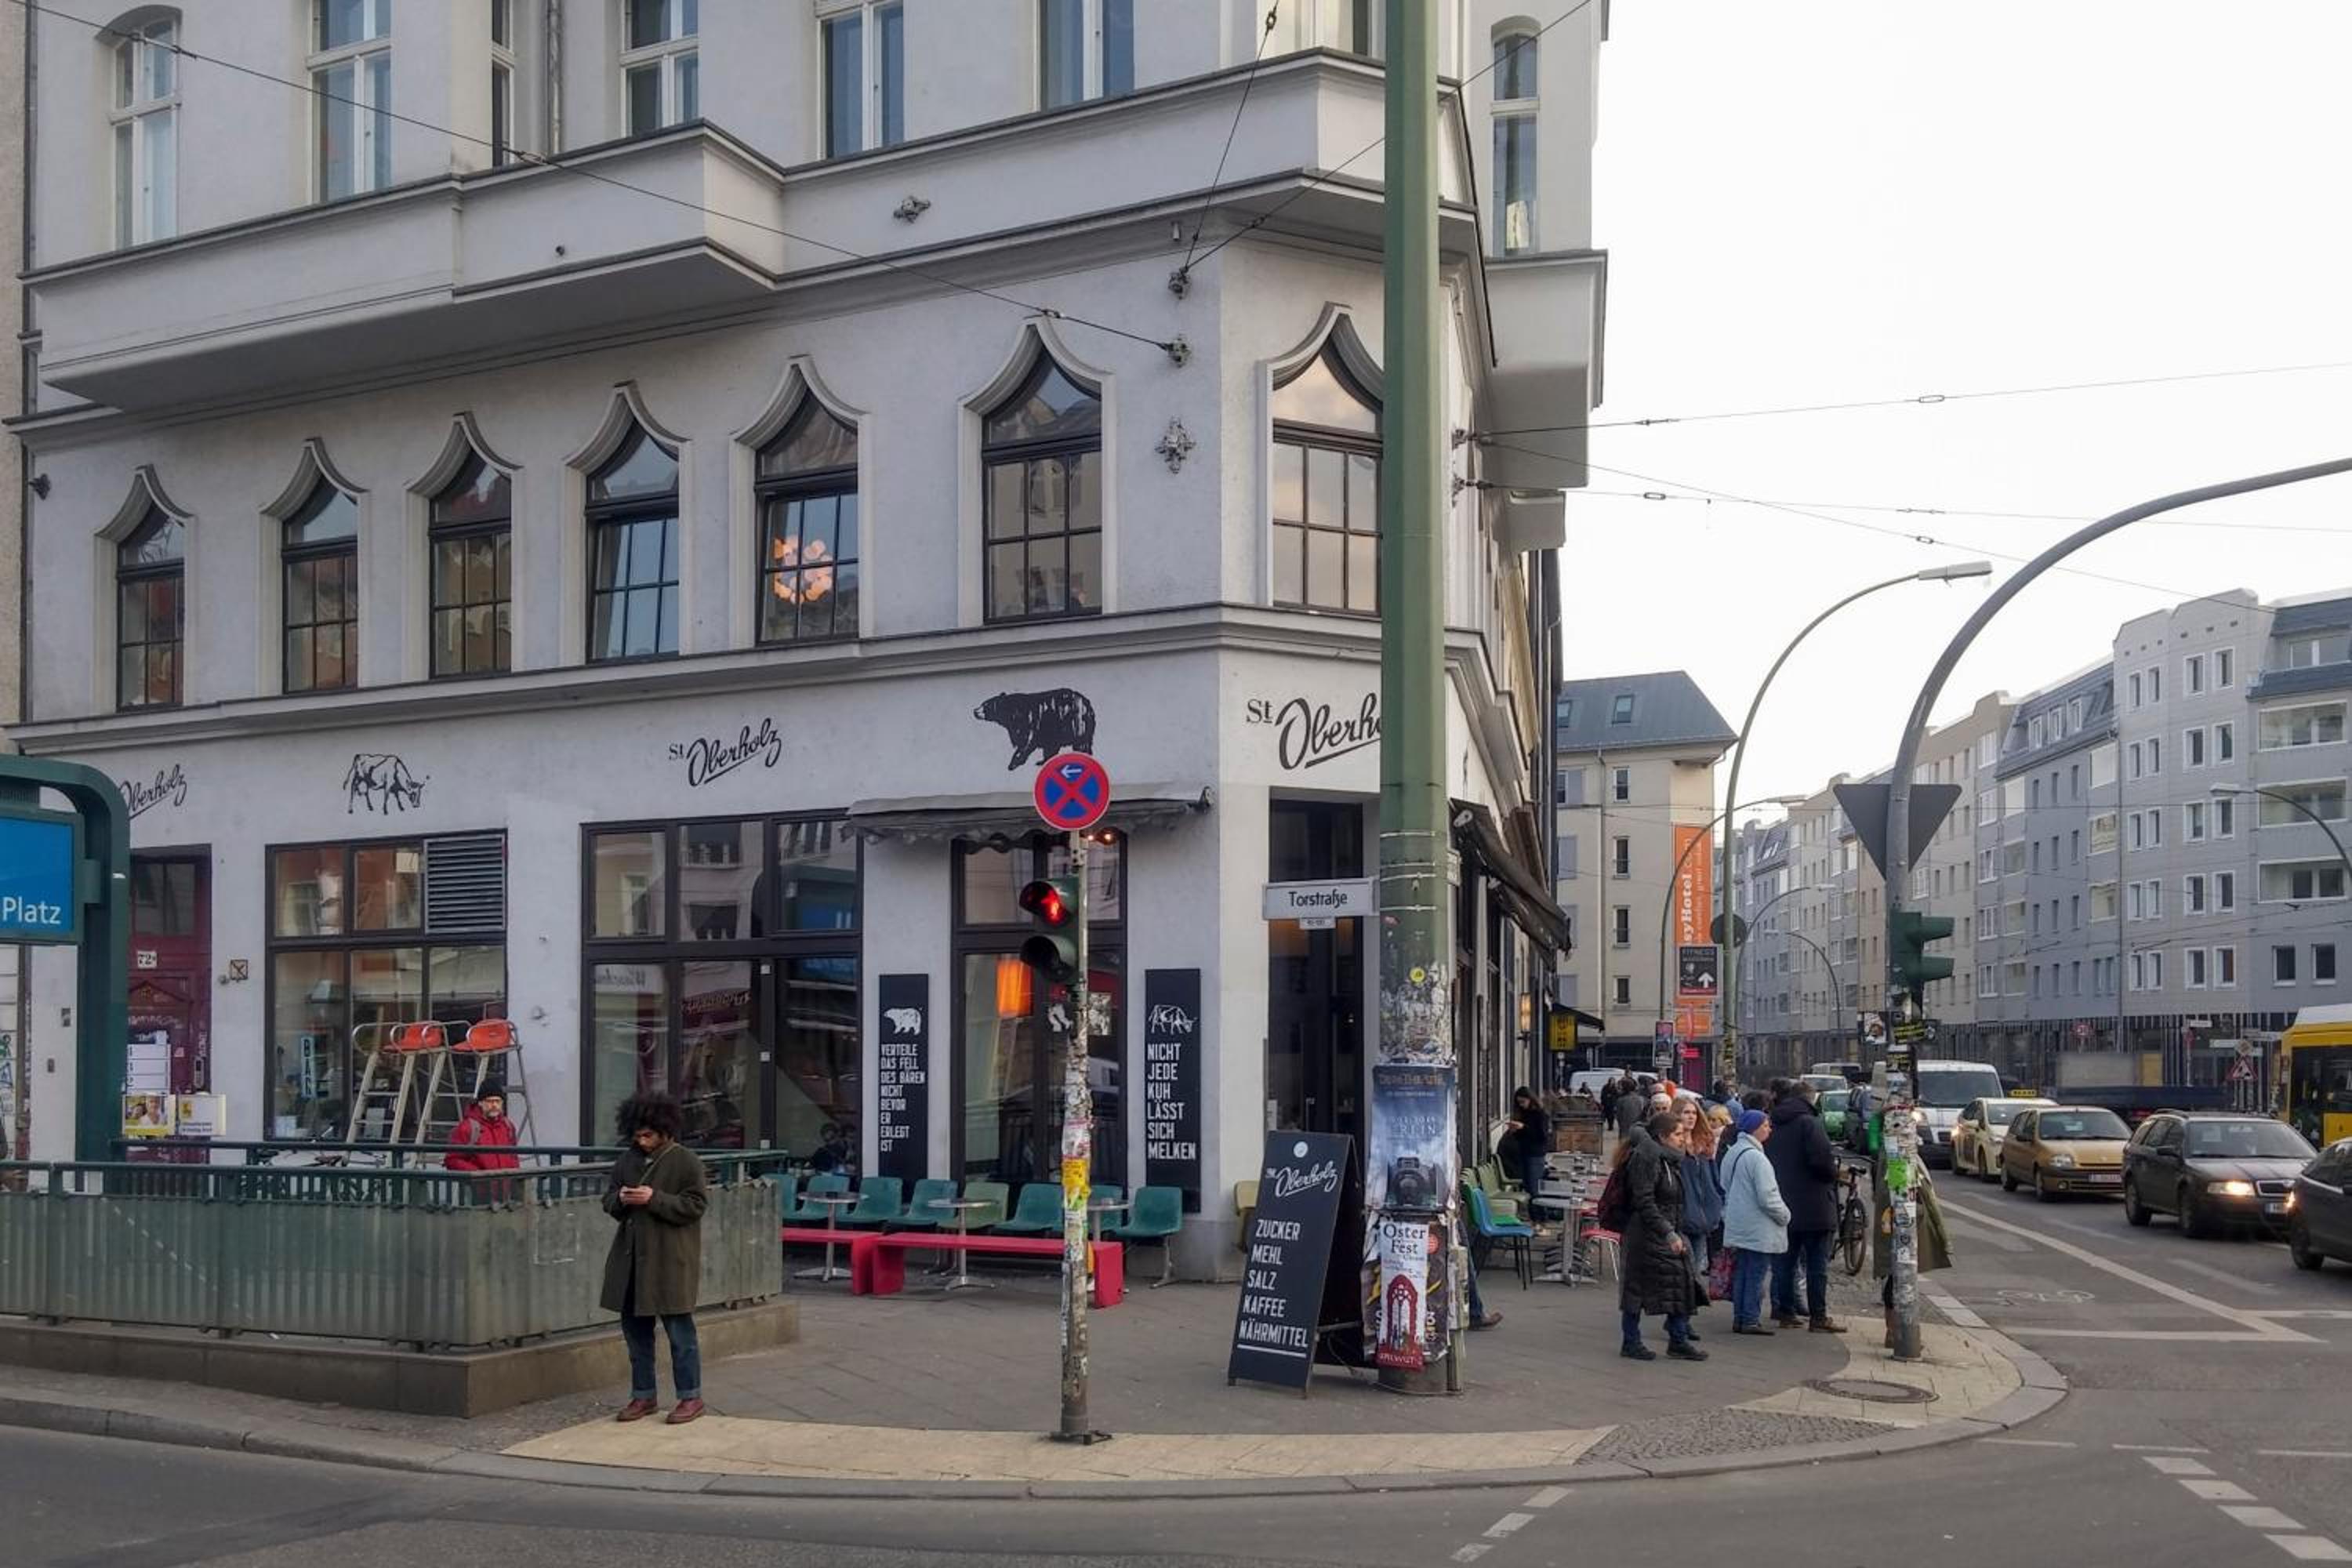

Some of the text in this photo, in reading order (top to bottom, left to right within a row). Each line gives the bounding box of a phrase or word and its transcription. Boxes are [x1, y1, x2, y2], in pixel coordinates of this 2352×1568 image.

[1247, 692, 1381, 769] St Oberh
[669, 717, 782, 786] St Oberholz
[1288, 888, 1348, 909] Torstraße
[2, 896, 62, 925] Platz
[880, 1044, 918, 1056] VERTEILE
[1147, 1043, 1181, 1061] NICHT
[880, 1056, 919, 1070] DAS FELL
[1147, 1062, 1178, 1080] JEDE
[880, 1070, 896, 1083] DES
[880, 1084, 903, 1097] NICHT
[1147, 1082, 1171, 1100] KUH
[880, 1112, 891, 1124] ER
[1147, 1099, 1185, 1120] LÄSST
[880, 1125, 909, 1138] ERLEGT
[1147, 1122, 1175, 1139] SICH
[880, 1139, 893, 1152] IST
[1147, 1141, 1196, 1160] MELKEN
[1274, 1160, 1338, 1197] Oberholz
[1255, 1218, 1301, 1241] ZUCKER
[1383, 1223, 1426, 1240] Oster
[1250, 1243, 1283, 1265] MEHL
[1391, 1238, 1418, 1254] Fest
[1247, 1269, 1277, 1290] SALZ
[1242, 1294, 1287, 1318] KAFFEE
[1237, 1318, 1308, 1348] NÄHRMITTEL
